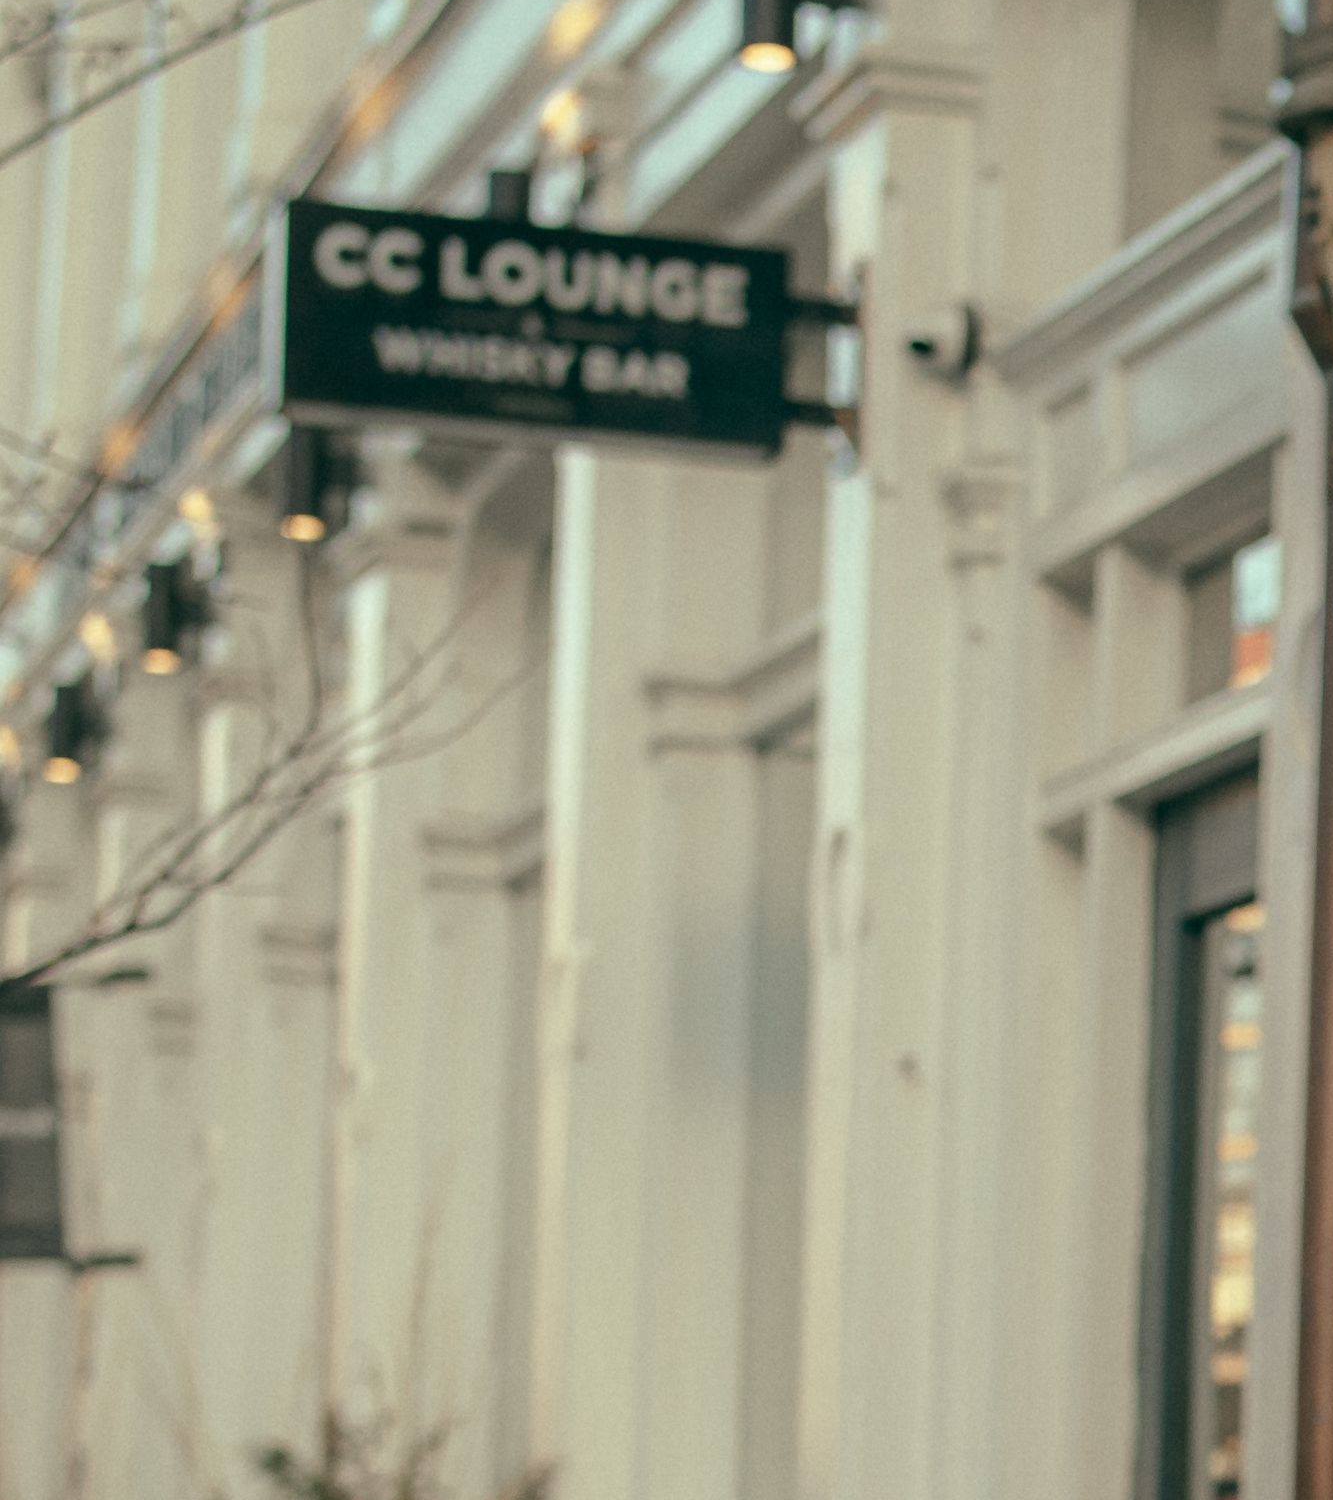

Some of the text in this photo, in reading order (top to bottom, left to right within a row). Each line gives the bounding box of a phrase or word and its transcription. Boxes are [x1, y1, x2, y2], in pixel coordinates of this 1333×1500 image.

[314, 222, 751, 327] CC LOUNGE
[373, 324, 690, 399] WHISKY BAR
